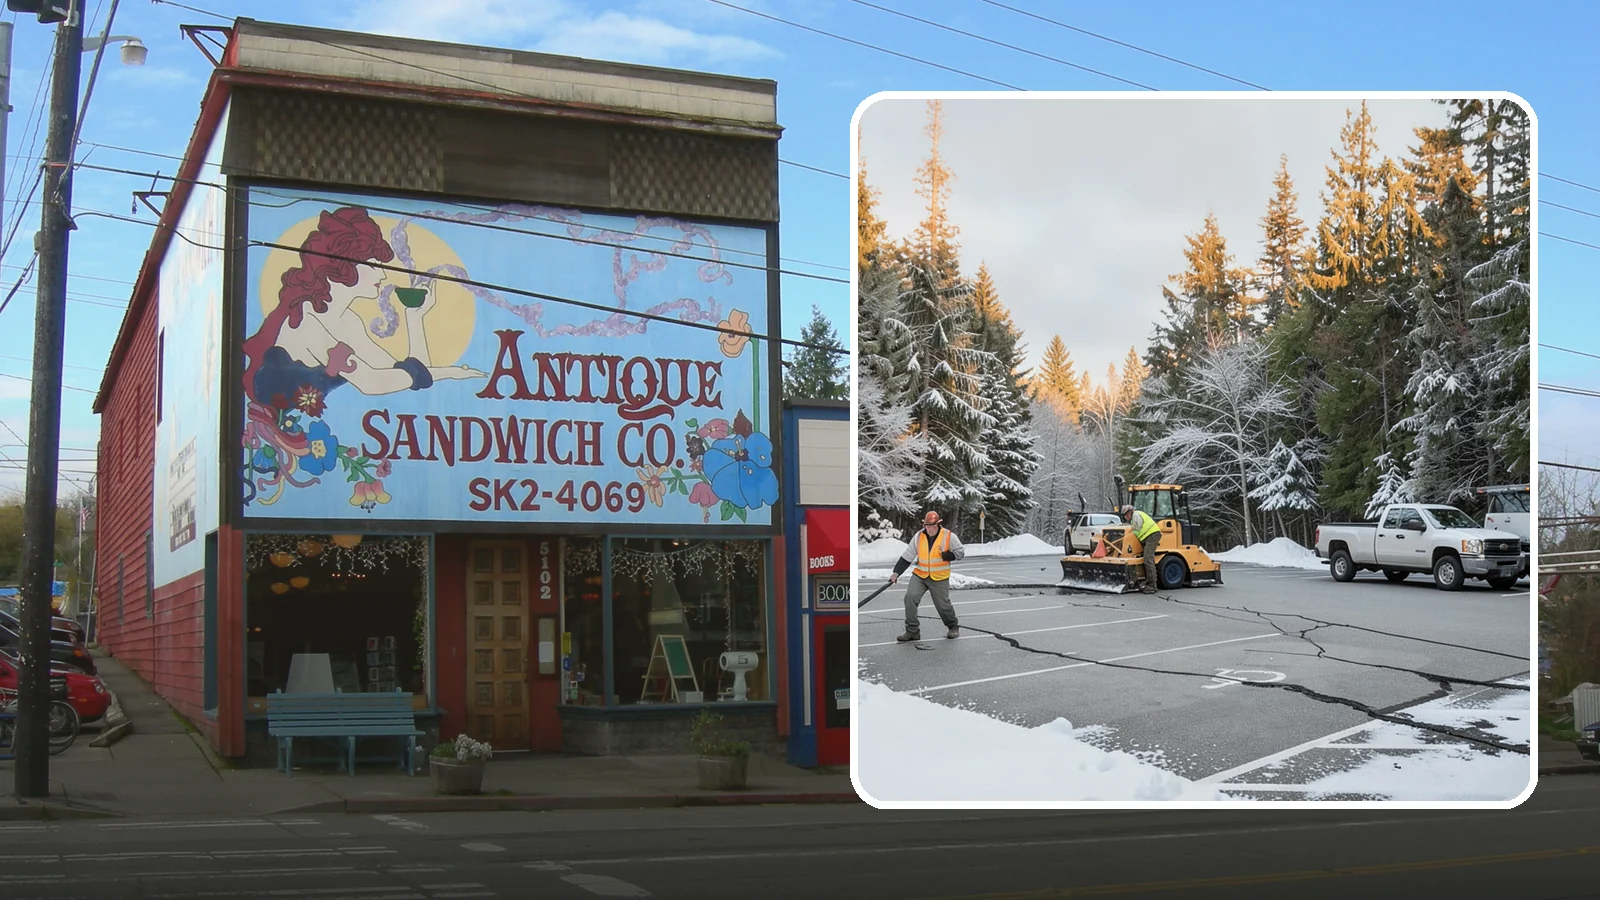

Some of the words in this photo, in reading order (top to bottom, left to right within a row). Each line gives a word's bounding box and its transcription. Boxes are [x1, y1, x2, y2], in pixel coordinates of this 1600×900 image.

[475, 329, 724, 421] ANTIQUE
[361, 409, 605, 467] SANDWICH
[617, 422, 685, 469] CO.
[468, 478, 646, 513] SK2-4069
[540, 541, 551, 600] 5102
[809, 555, 835, 569] BOOKS
